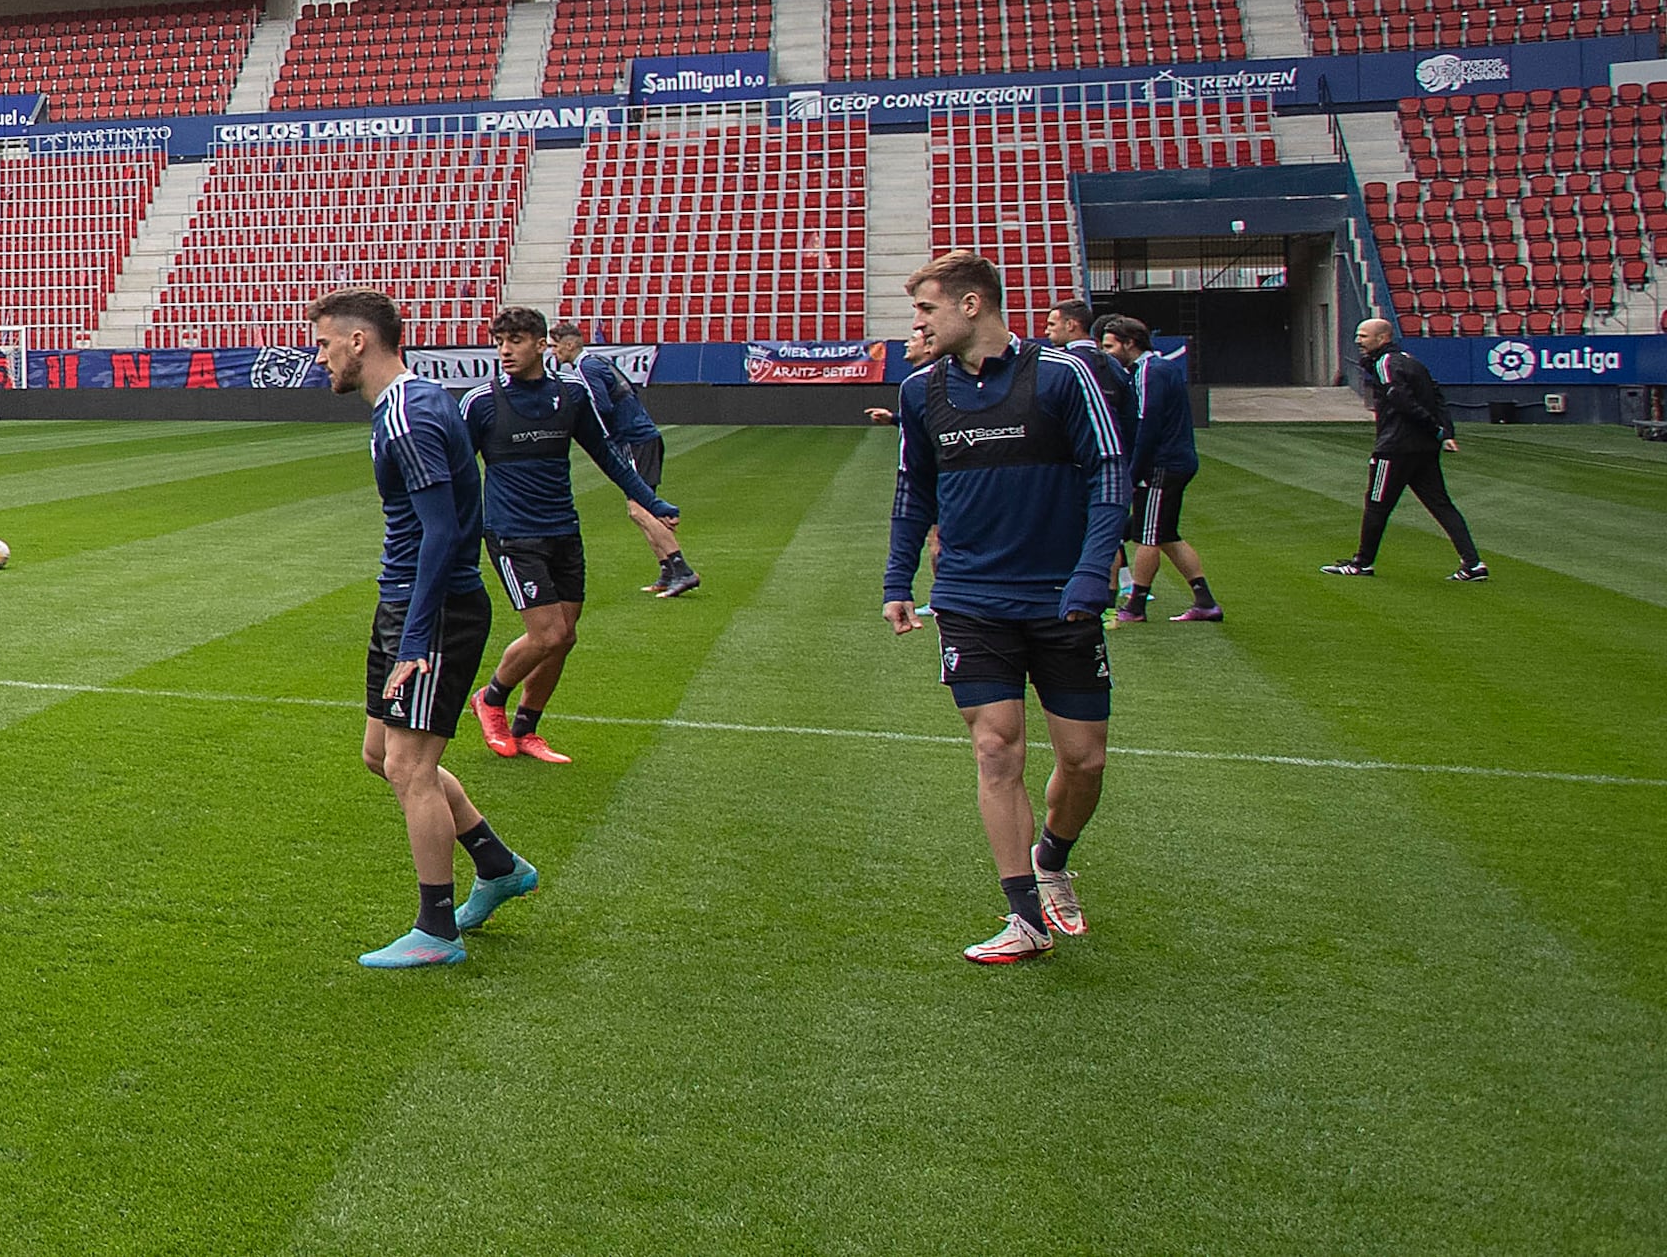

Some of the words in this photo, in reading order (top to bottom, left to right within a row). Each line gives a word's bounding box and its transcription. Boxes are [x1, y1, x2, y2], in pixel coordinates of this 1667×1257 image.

[641, 69, 741, 95] SanMiguel
[829, 95, 882, 113] CEOP
[220, 124, 304, 143] CICLOS
[310, 118, 415, 139] LAREQUI
[479, 107, 610, 132] PAVANA
[70, 125, 172, 144] MARTINTXO
[813, 345, 867, 358] TALDEA
[1540, 346, 1622, 374] LaLiga
